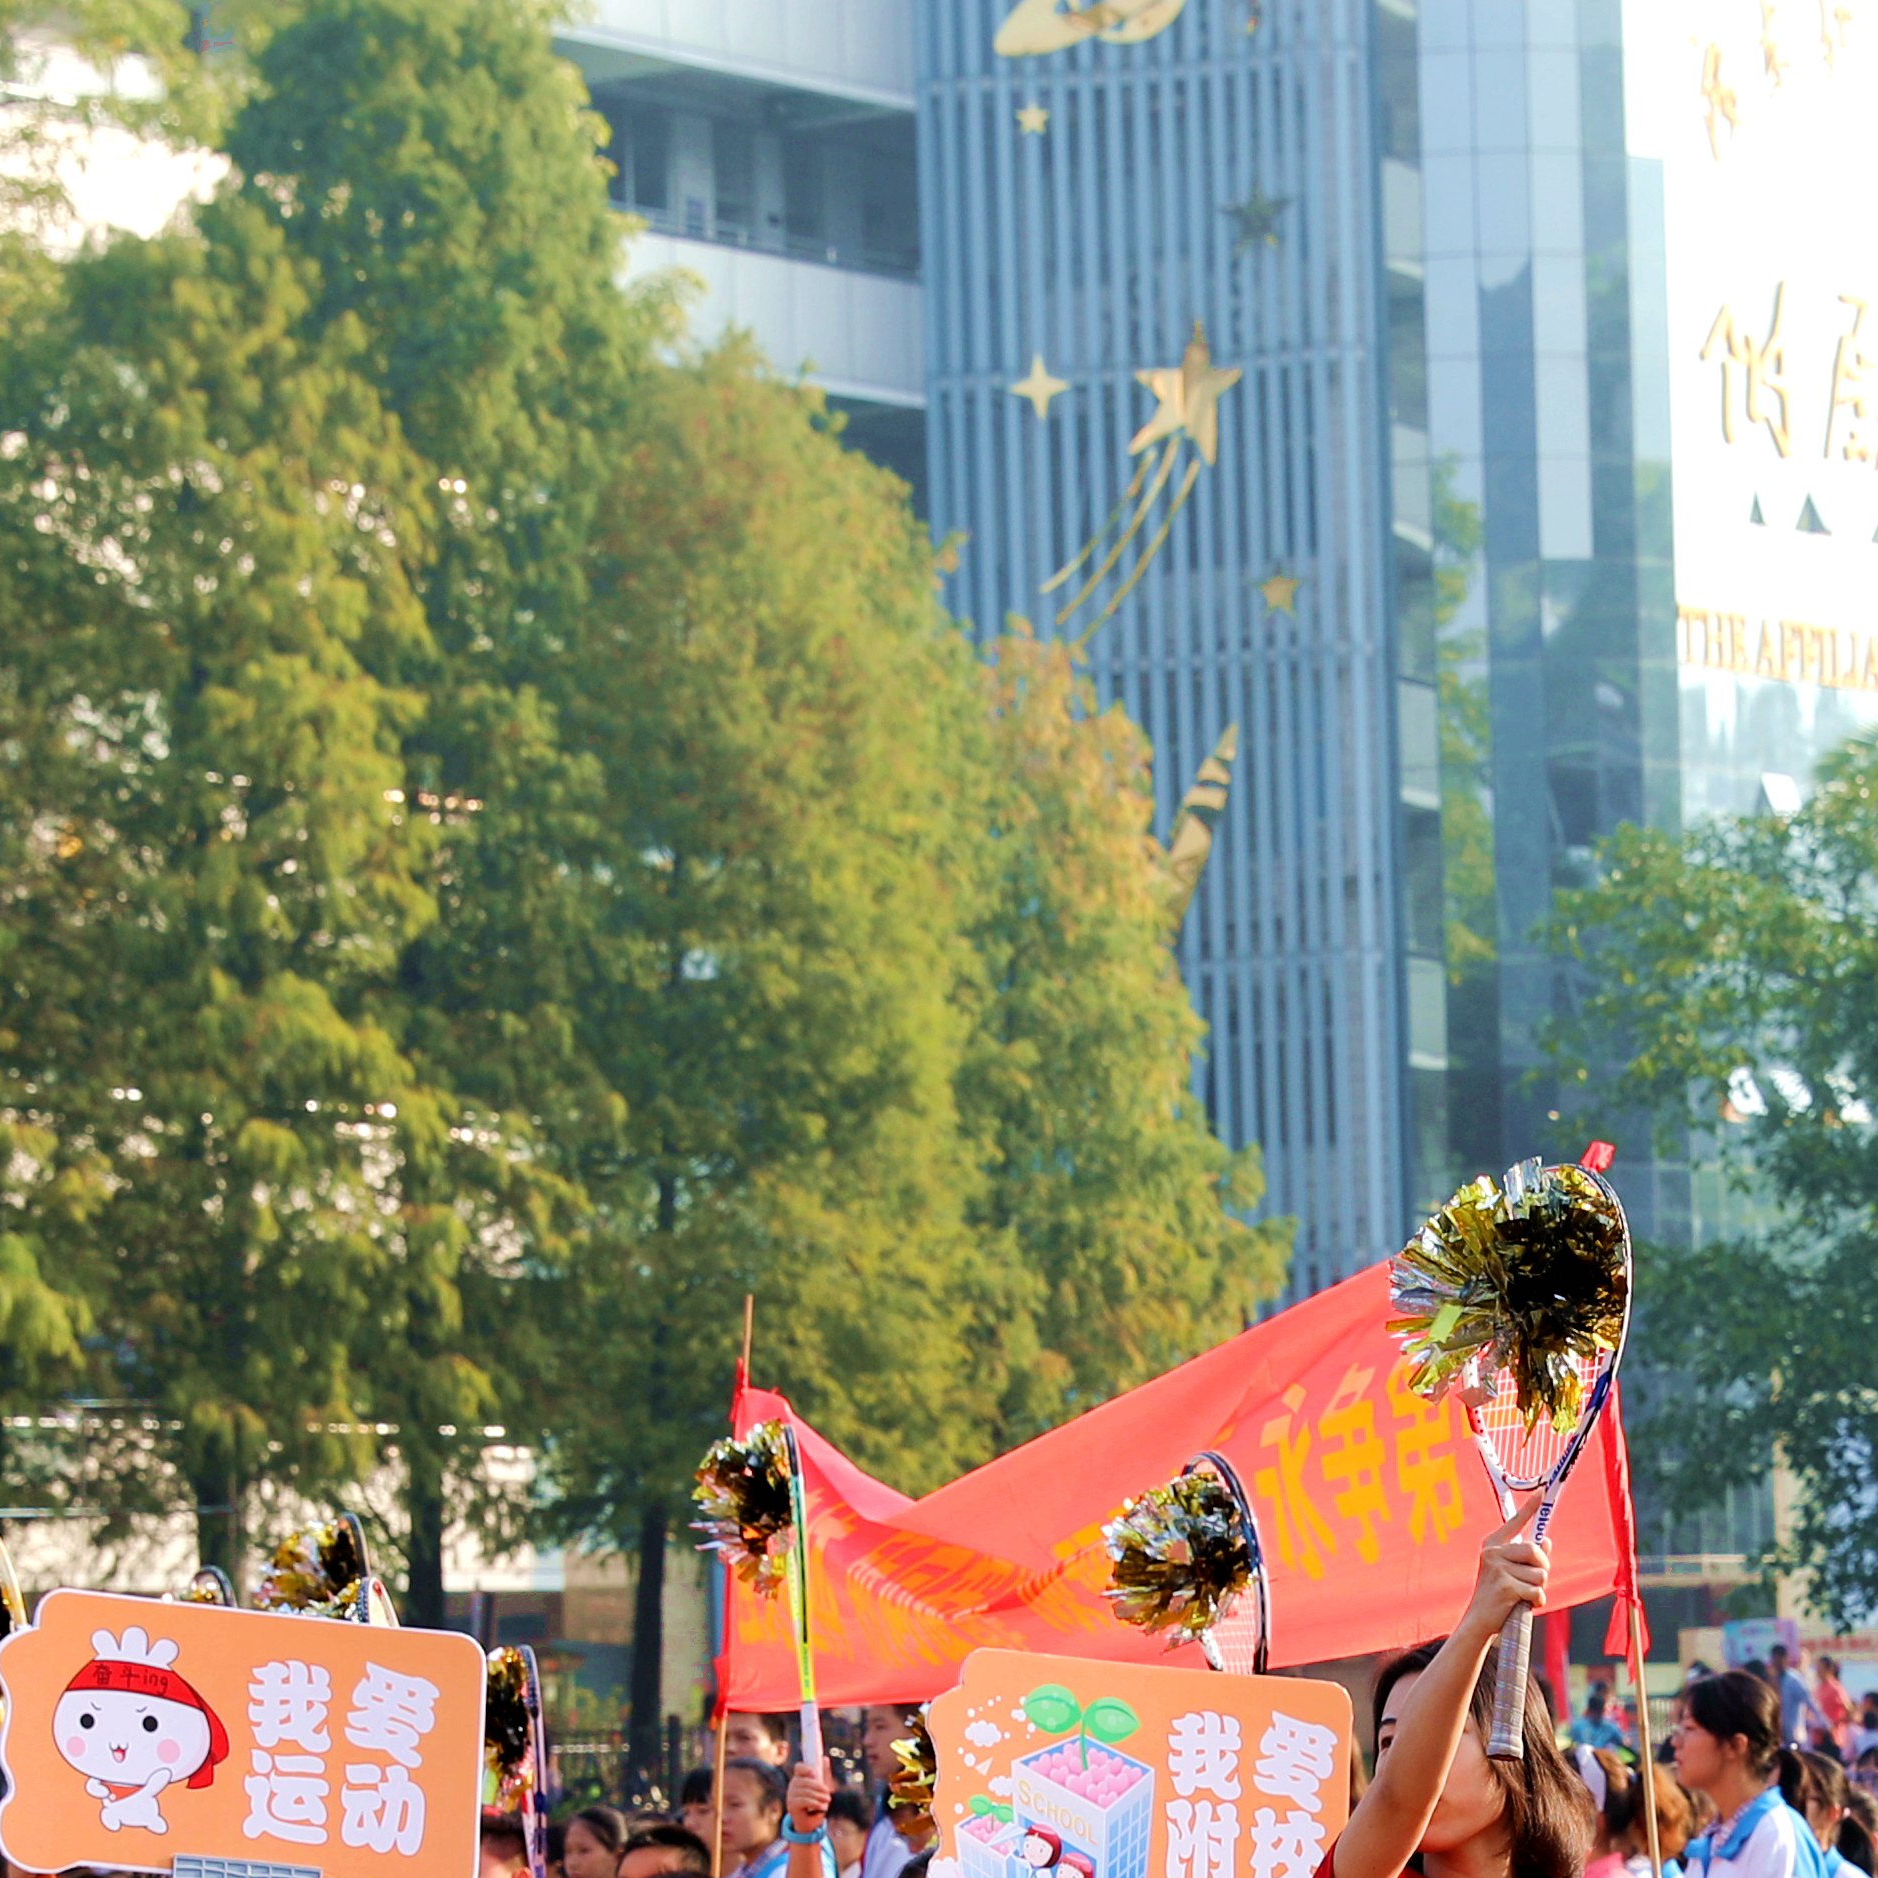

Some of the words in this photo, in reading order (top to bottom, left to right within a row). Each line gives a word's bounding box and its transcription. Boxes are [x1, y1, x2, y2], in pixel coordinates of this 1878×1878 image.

[1677, 604, 1748, 672] THE
[247, 1659, 440, 1769] 我爱
[1166, 1709, 1339, 1813] 我爱
[242, 1750, 426, 1857] 运动
[1018, 1779, 1099, 1846] SCHOOL
